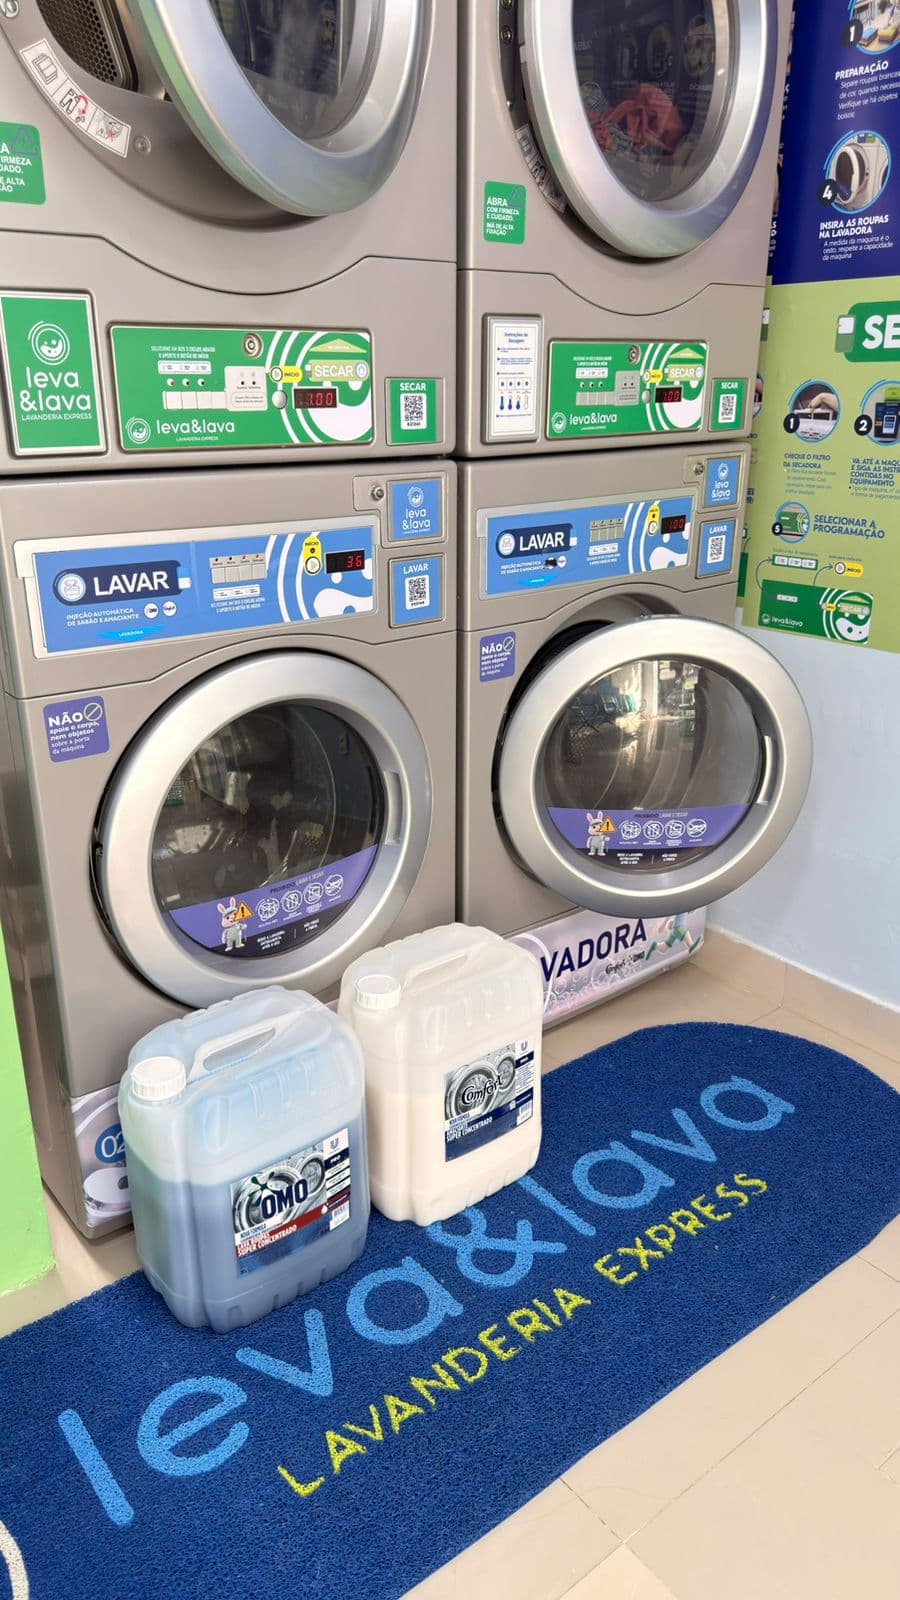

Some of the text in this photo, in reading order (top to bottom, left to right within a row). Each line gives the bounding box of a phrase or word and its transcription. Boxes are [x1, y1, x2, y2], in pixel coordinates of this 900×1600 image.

[849, 25, 856, 43] 1
[835, 60, 889, 80] PREPARAÇÃO
[9, 178, 25, 186] ALTA
[822, 185, 833, 200] 4
[486, 197, 508, 207] ABRA
[819, 214, 889, 231] INSIRA AS ROUPAS
[818, 225, 872, 239] NA LAVADORA
[314, 364, 354, 377] SECAR
[669, 366, 694, 378] SECAR
[26, 367, 79, 388] leva
[400, 382, 426, 391] SECAR
[20, 389, 91, 412] &lava
[21, 412, 92, 421] LAVANDERIA EXPRESS
[569, 412, 617, 425] leva&lava
[788, 417, 795, 429] 1
[156, 419, 235, 434] leva&lava
[859, 420, 868, 432] 2
[784, 452, 805, 461] CHEQUE
[861, 457, 874, 466] ATÉ
[792, 462, 821, 470] SECADORA
[713, 480, 728, 489] leva
[850, 478, 895, 487] EQUIPAMENTO
[711, 489, 730, 499] &lava
[405, 508, 427, 519] leva
[402, 518, 431, 531] &lava
[814, 514, 877, 529] SELECIONAR A
[709, 524, 727, 534] LAVAR
[773, 524, 780, 533] 5
[813, 524, 886, 540] PROGRAMAÇÃO
[519, 531, 564, 551] LAVAR
[348, 556, 362, 568] 36
[403, 563, 429, 574] LAVAR
[93, 571, 169, 597] LAVAR
[66, 607, 134, 621] INJEÇÃO AUTOMÁTICA
[77, 617, 99, 626] SABÃO
[104, 613, 139, 624] AMACIANTE
[481, 643, 503, 655] NÃO
[48, 711, 83, 727] NÃO
[68, 729, 94, 738] objetos
[540, 918, 646, 982] VADORA
[462, 1072, 504, 1105] Comfort
[261, 1178, 308, 1220] OMO
[238, 1224, 297, 1258] SUPER CONCENTRADO
[58, 1074, 796, 1527] leva&lava
[276, 1172, 768, 1499] LAVANDERIA EXPRESS
